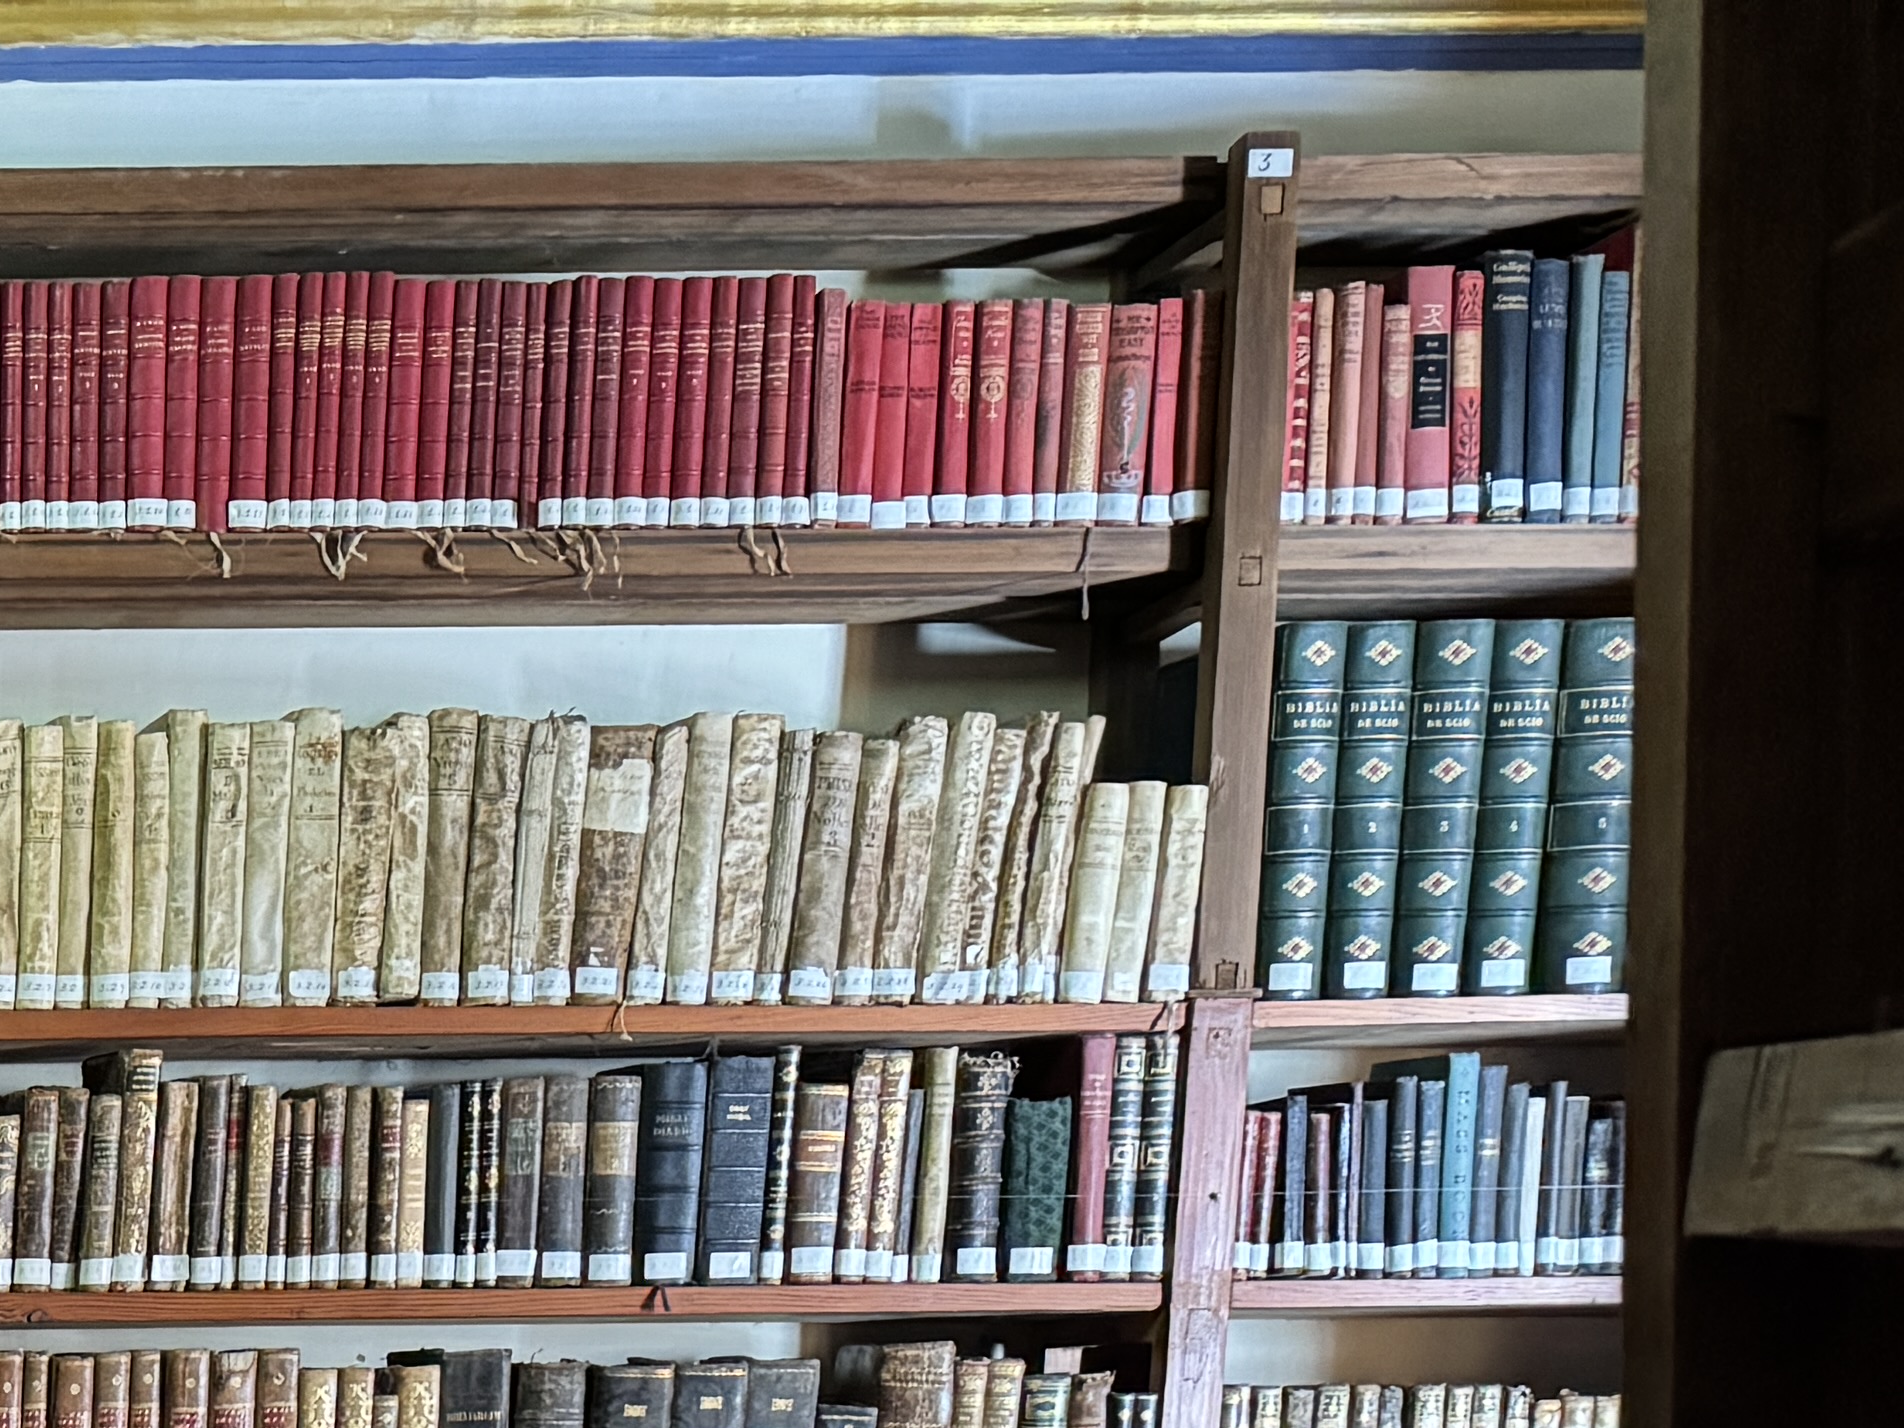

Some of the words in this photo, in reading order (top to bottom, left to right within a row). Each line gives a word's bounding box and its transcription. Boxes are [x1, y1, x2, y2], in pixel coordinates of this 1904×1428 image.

[1257, 153, 1272, 172] 3
[1286, 702, 1338, 713] BIBLIA
[1350, 701, 1406, 713] BIBLIA
[1423, 701, 1481, 713] BIBLIA
[1493, 701, 1551, 712] BIBLIA
[1580, 698, 1631, 710] BIBLI
[1367, 821, 1378, 834] 2
